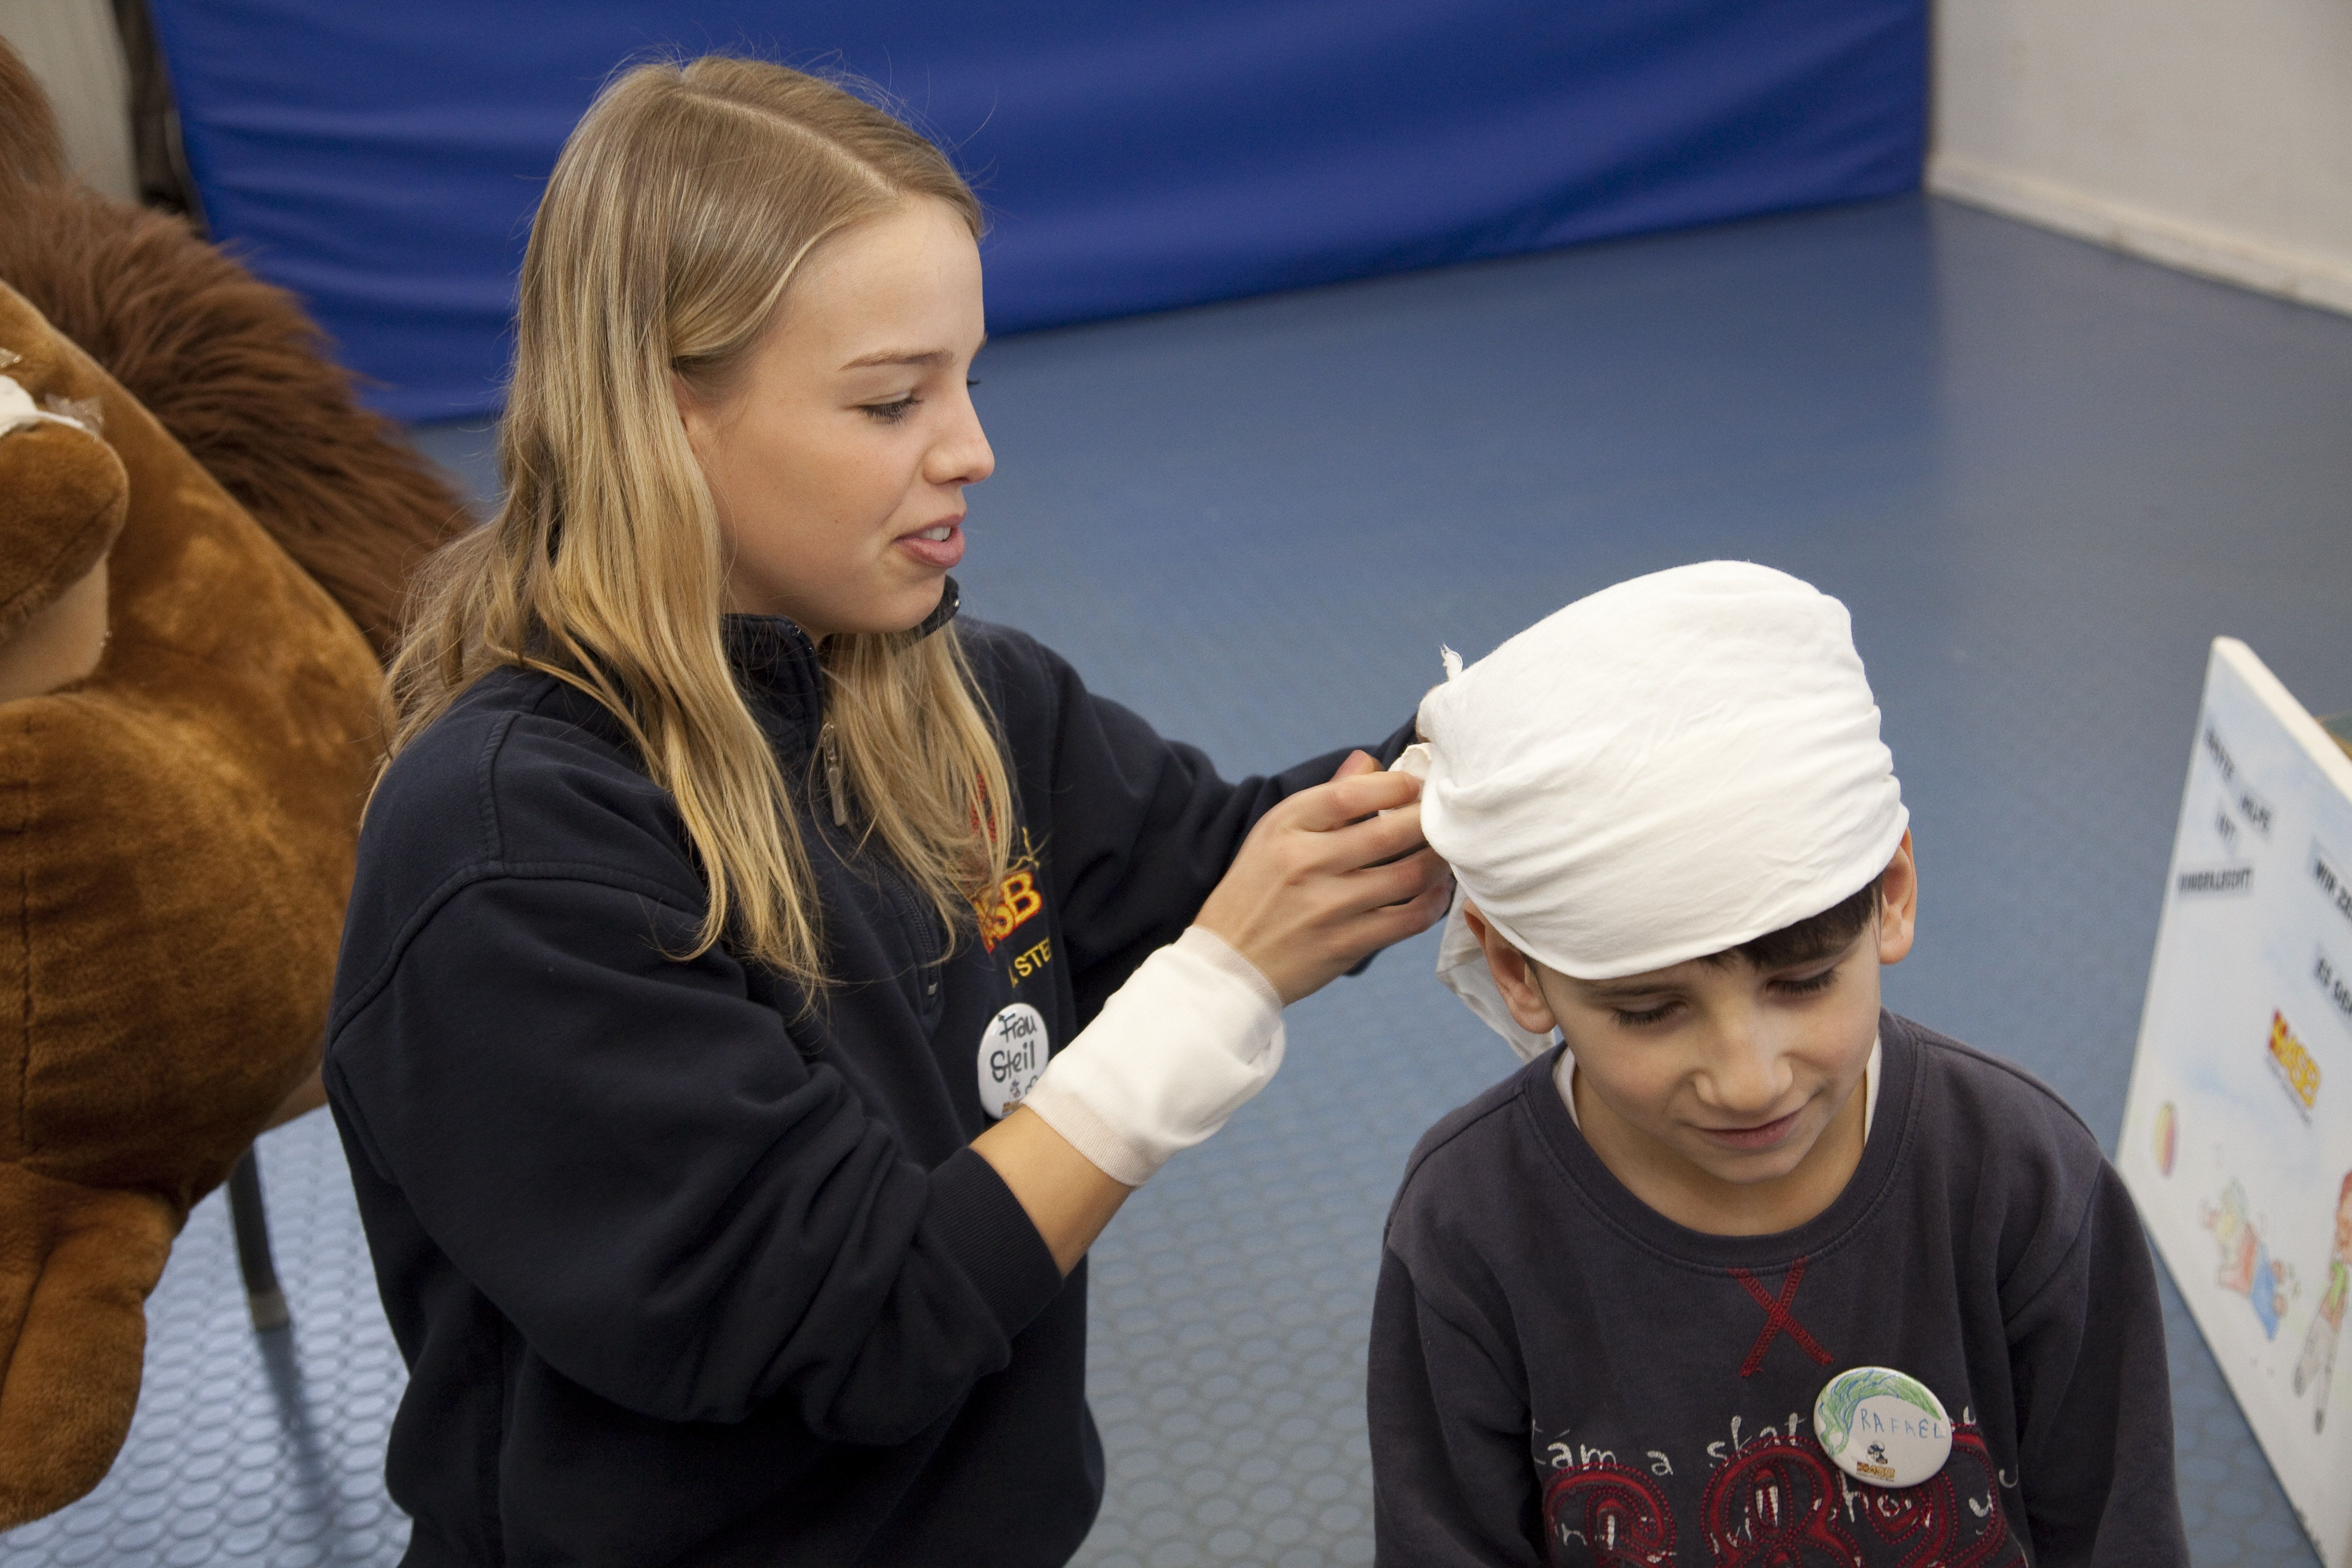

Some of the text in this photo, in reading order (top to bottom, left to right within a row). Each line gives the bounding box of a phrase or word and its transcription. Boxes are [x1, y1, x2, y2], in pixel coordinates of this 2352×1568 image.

[998, 1013, 1037, 1042] Frau
[990, 1039, 1034, 1083] Steil
[1861, 1408, 1945, 1439] RAFAEL
[1647, 1450, 1673, 1476] a
